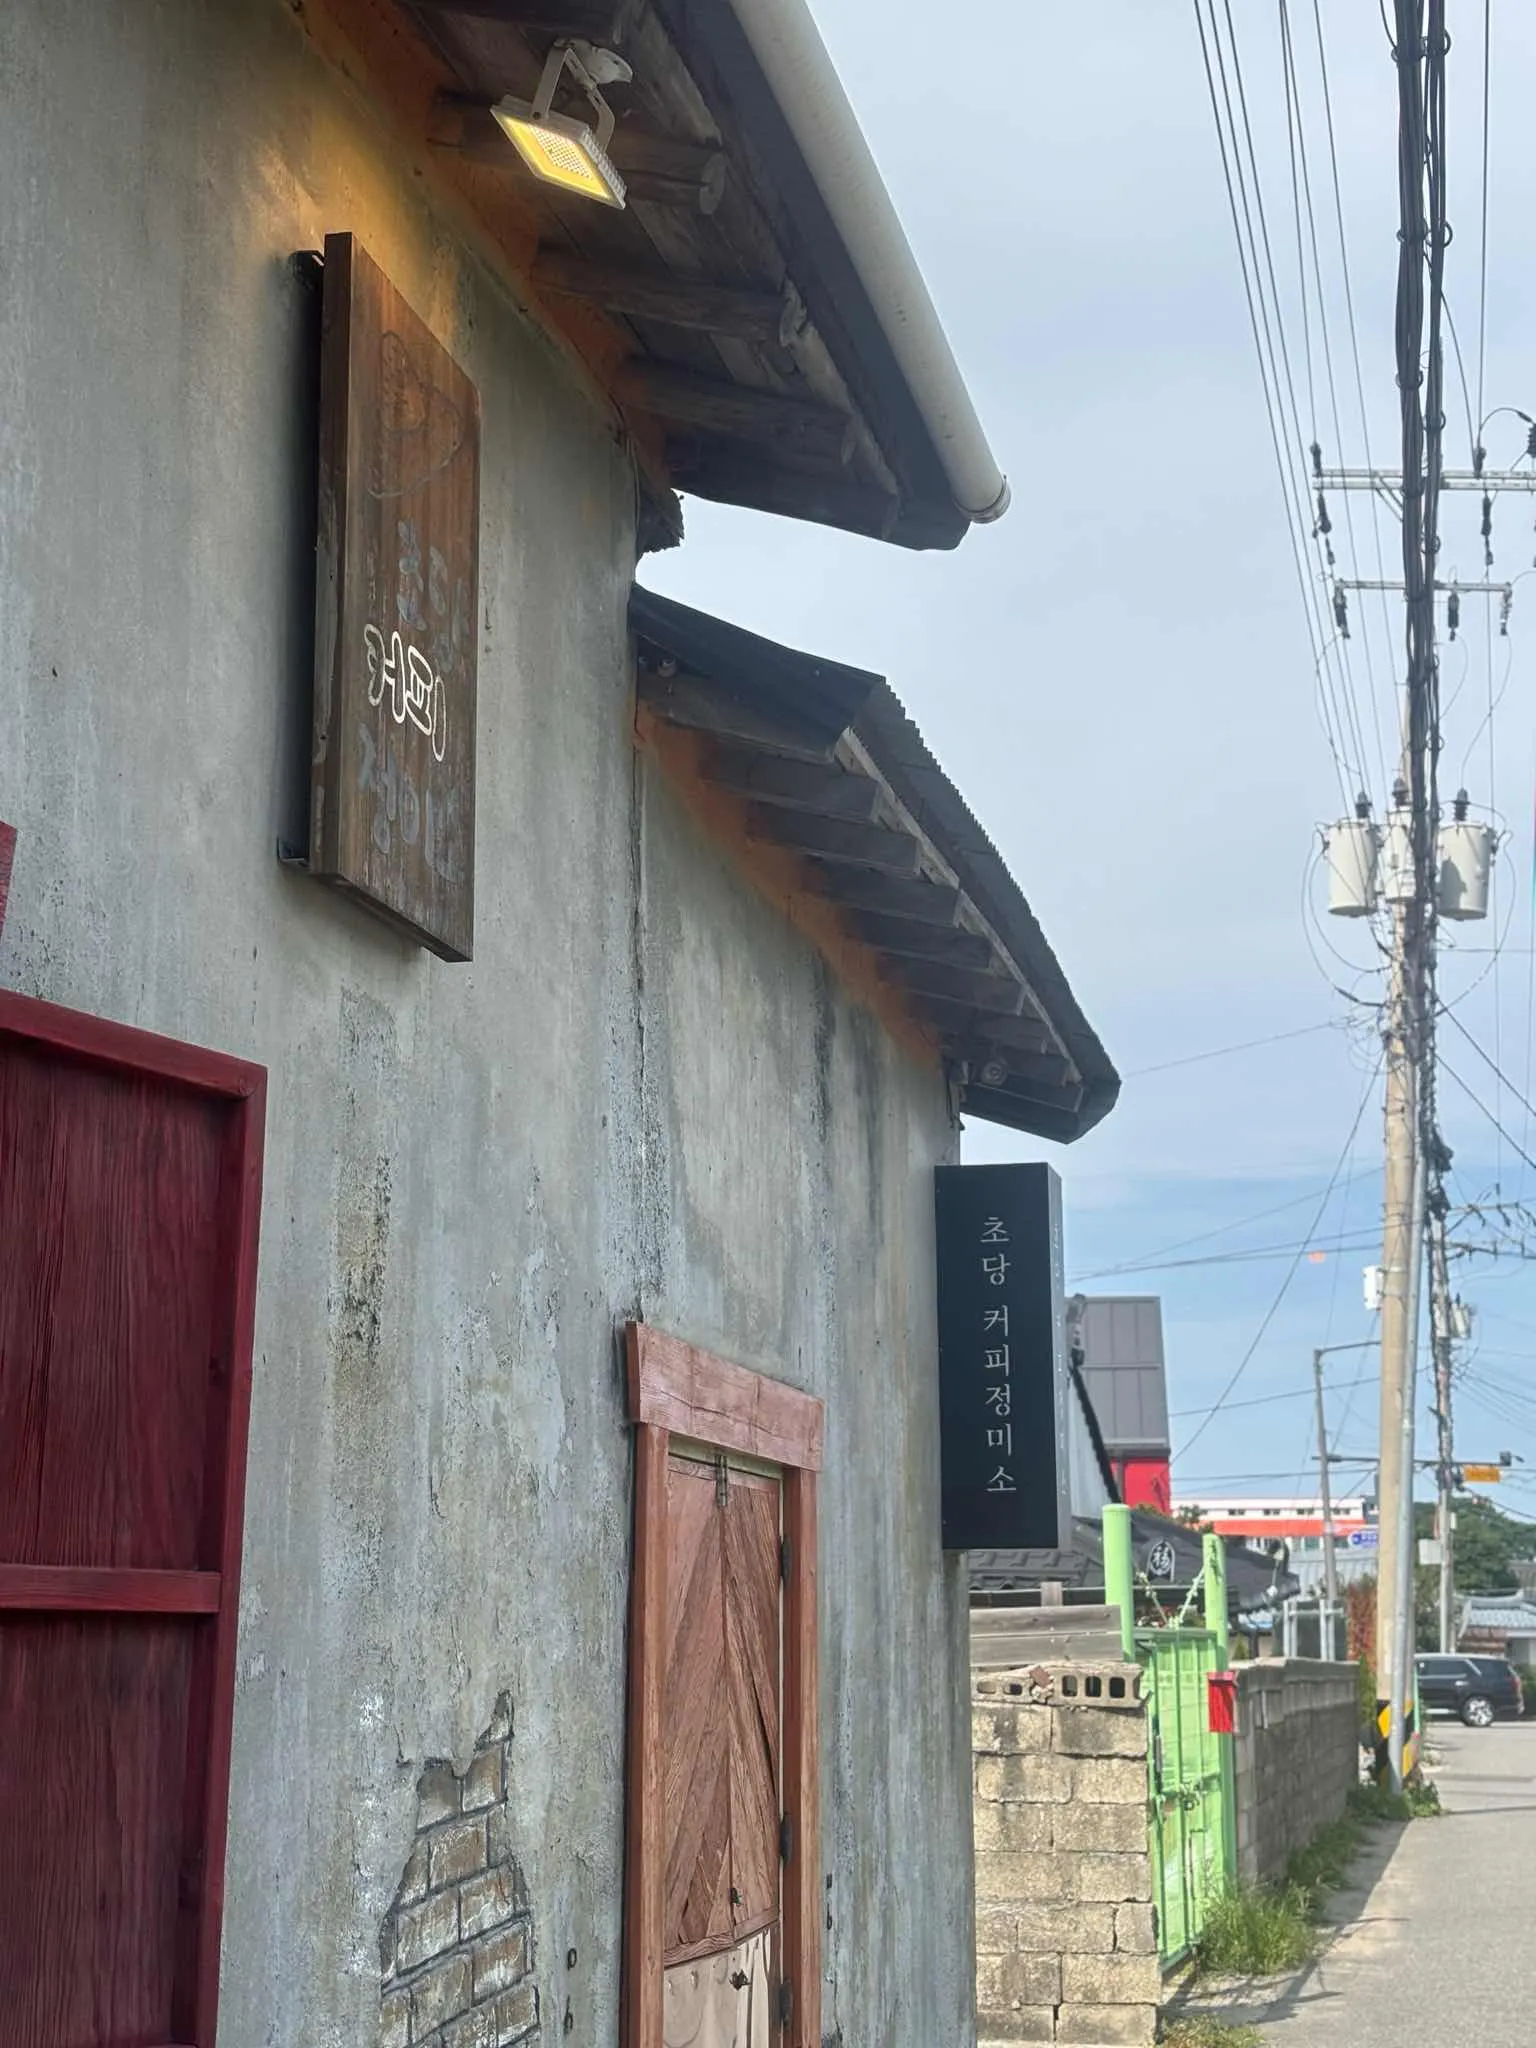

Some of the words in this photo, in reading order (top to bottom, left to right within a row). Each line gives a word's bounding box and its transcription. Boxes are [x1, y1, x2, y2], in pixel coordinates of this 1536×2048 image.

[398, 520, 469, 672] 초당
[364, 623, 446, 762] 커피
[980, 1216, 1012, 1284] 초당
[984, 1304, 1017, 1492] 커피정미소
